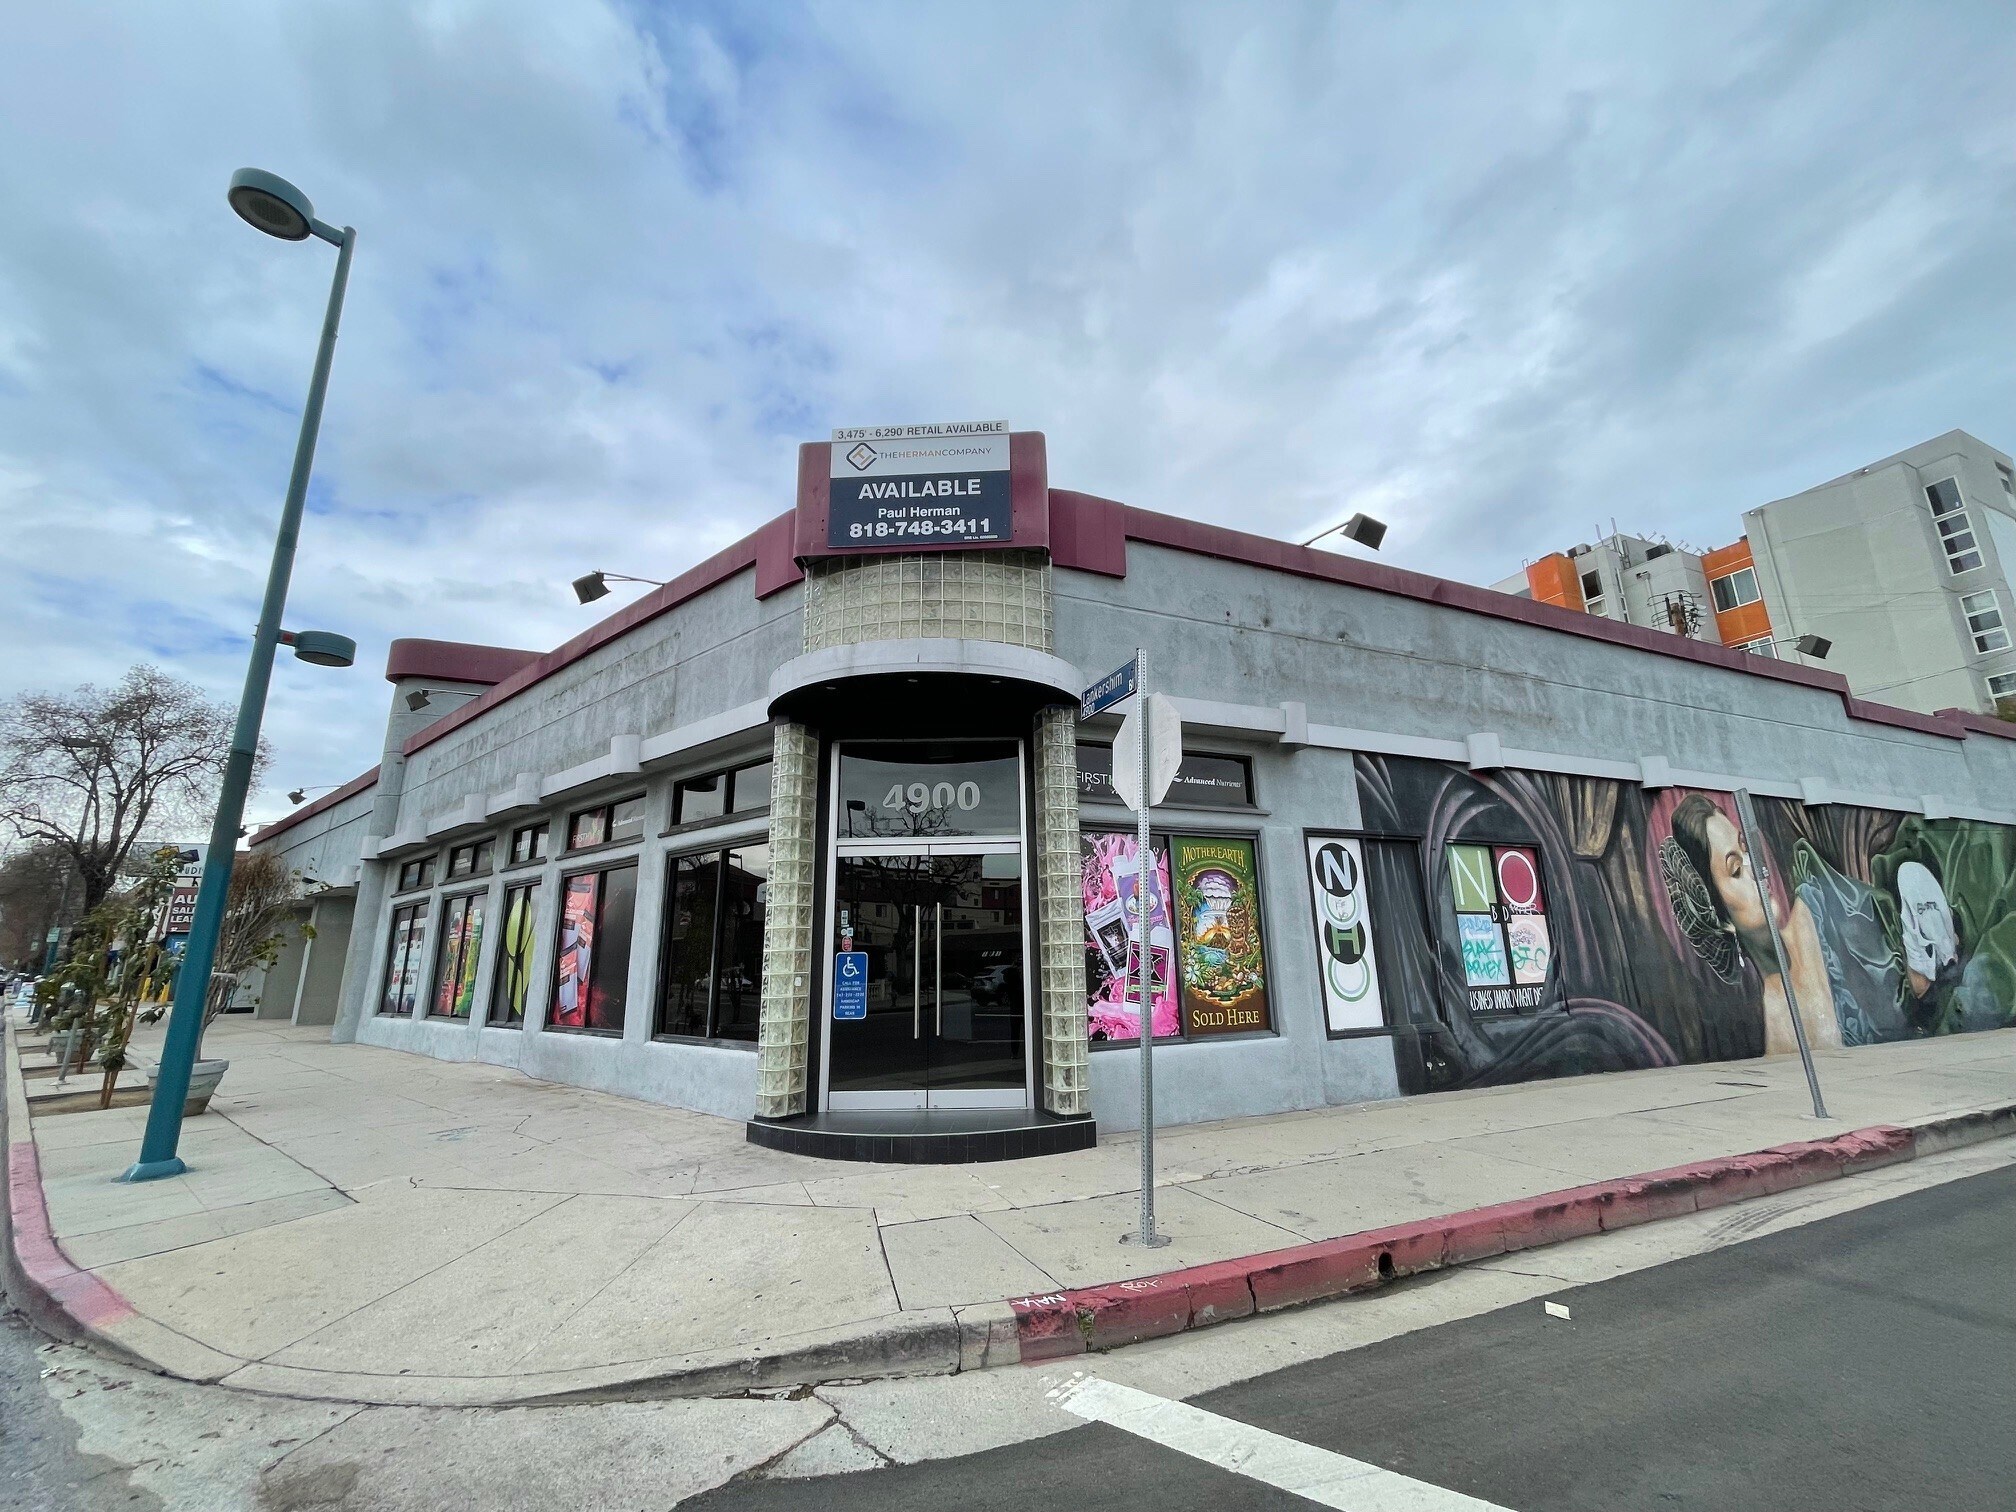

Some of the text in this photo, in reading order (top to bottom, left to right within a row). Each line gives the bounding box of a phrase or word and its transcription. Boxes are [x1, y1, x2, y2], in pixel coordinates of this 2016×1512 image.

[838, 429, 867, 440] 3,475'
[875, 427, 904, 438] 6,290'
[907, 424, 943, 436] RETAIL
[946, 422, 1003, 434] AVAILABLE
[879, 447, 992, 459] THEHERMANCOMPANY
[858, 478, 982, 500] AVAILABLE
[878, 506, 961, 519] Paul Herman
[849, 517, 990, 538] 818-748-3411
[1082, 672, 1122, 708] Lankershim
[1184, 776, 1215, 786] Advanced
[1216, 778, 1242, 788] Nutrients
[882, 781, 981, 813] 4900
[1182, 847, 1245, 868] MOTHER EARTH
[174, 894, 198, 904] AU
[1469, 990, 1493, 1011] USINESS
[1192, 1008, 1260, 1028] SOLD HERE
